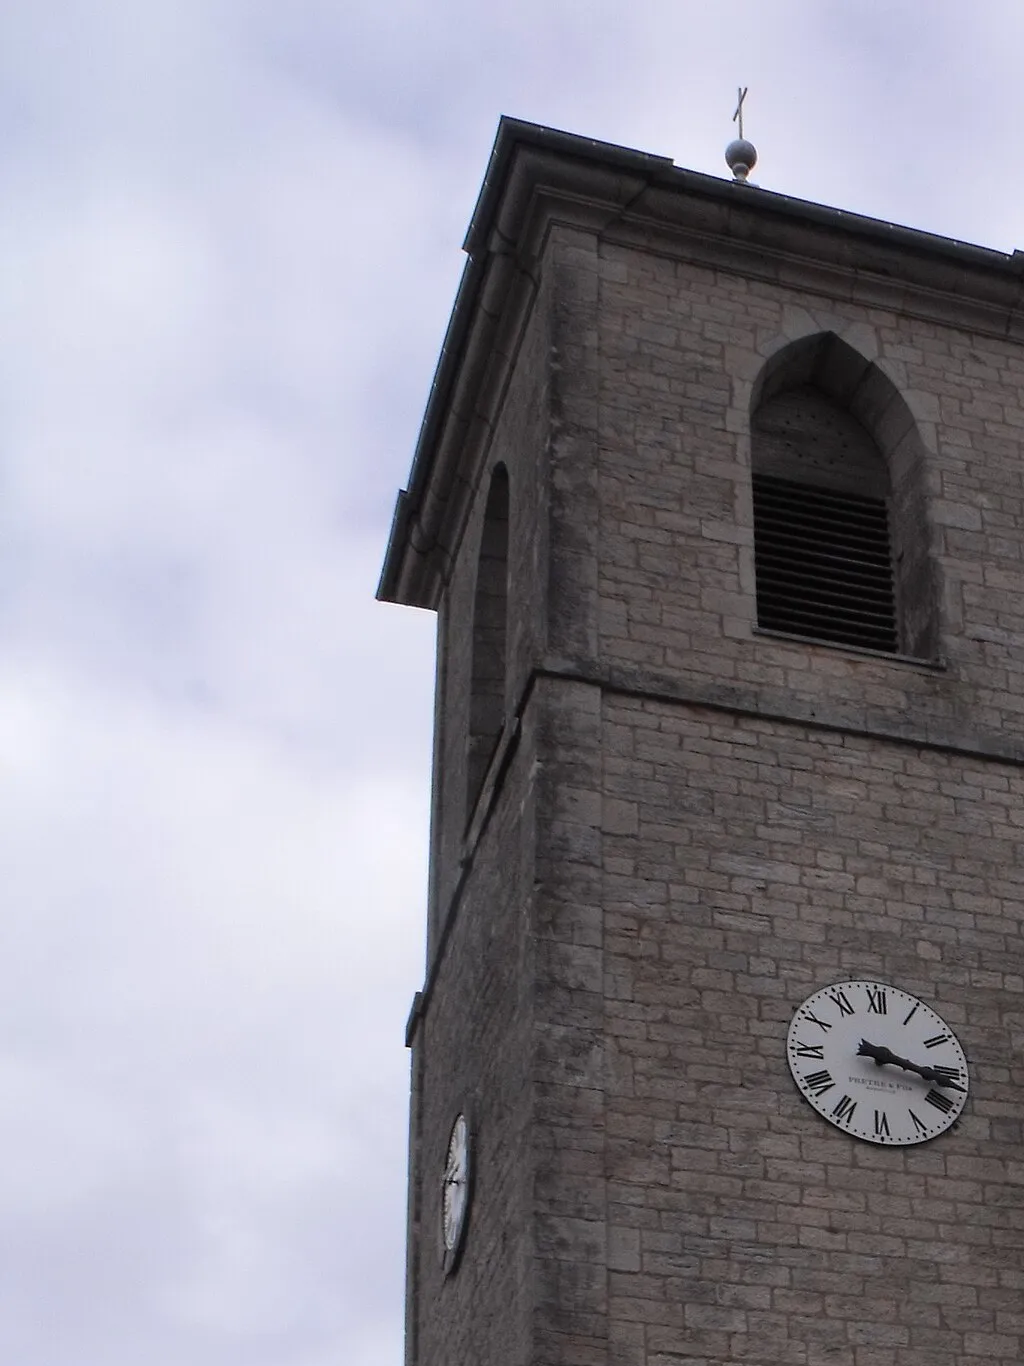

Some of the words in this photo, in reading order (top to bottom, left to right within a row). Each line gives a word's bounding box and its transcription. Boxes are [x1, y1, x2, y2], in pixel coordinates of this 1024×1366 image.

[829, 991, 856, 1018] XI
[866, 989, 887, 1015] XII
[804, 1011, 832, 1033] X
[903, 1006, 917, 1026] I
[796, 1041, 824, 1060] IX
[923, 1034, 949, 1049] II
[803, 1069, 836, 1097] VIII
[832, 1095, 858, 1124] VII
[924, 1089, 955, 1115] IIII
[874, 1109, 890, 1137] VI
[908, 1108, 928, 1133] V
